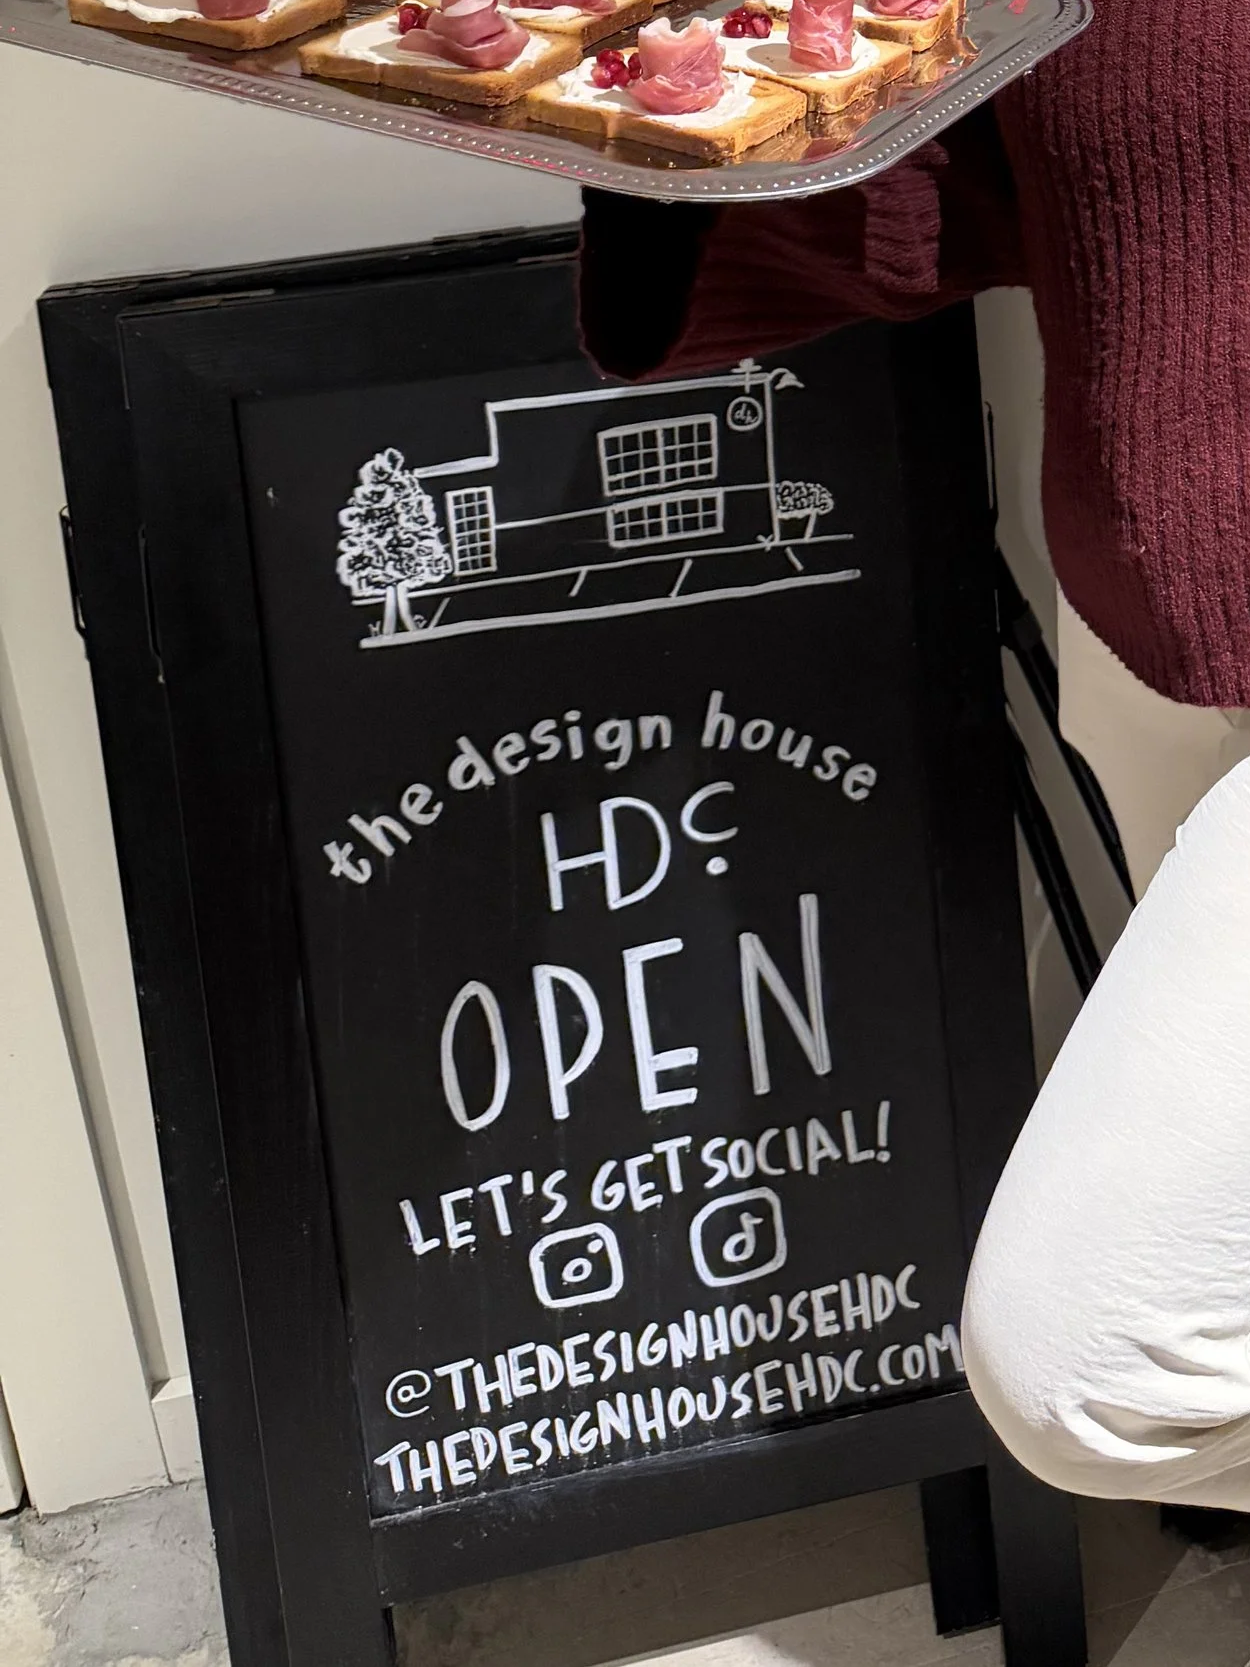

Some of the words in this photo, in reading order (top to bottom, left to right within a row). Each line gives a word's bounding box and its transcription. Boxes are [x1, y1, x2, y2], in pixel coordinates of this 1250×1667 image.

[323, 783, 443, 884] the
[448, 710, 672, 791] design
[701, 690, 877, 801] house
[440, 893, 832, 1132] OPEN
[398, 1170, 568, 1256] LET'S
[373, 1323, 965, 1502] THEDESIGNHOUSEHDC.COM
[385, 1264, 921, 1418] @THEDESIGNHOUSEHDC
